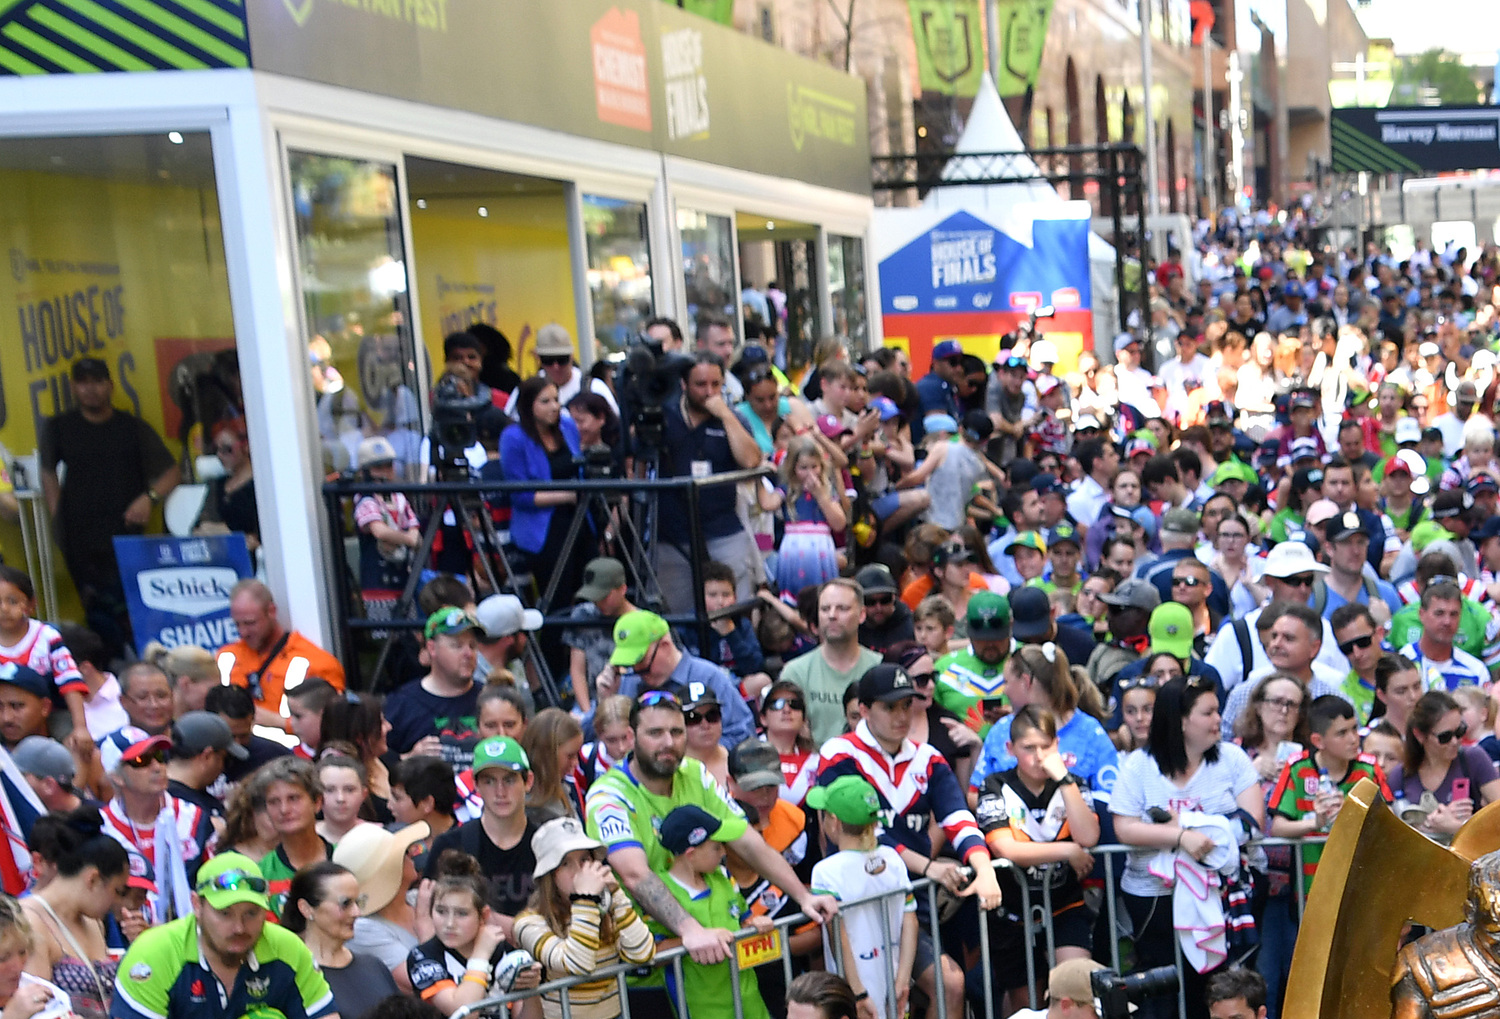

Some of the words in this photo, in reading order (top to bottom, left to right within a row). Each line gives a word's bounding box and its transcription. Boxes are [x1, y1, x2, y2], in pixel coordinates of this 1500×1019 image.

[1381, 124, 1435, 145] Harvey
[932, 252, 997, 289] FINALS
[18, 285, 105, 373] HOUSE
[150, 576, 231, 598] Schick
[688, 681, 706, 702] P
